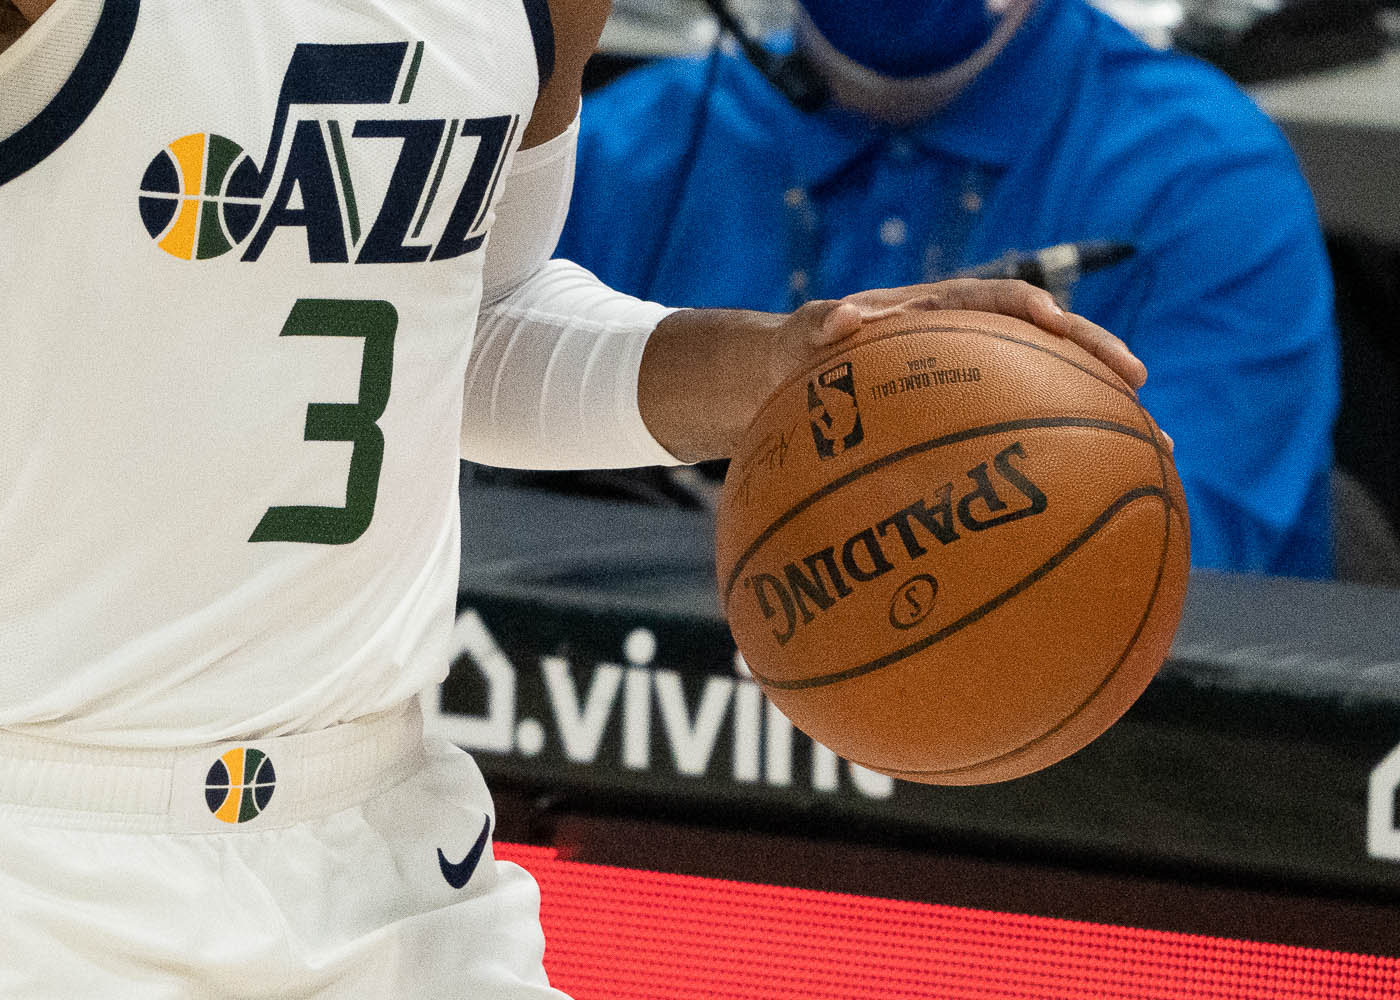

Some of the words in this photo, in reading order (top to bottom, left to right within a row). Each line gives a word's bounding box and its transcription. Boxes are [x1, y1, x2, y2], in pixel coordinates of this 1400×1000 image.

[138, 41, 519, 264] JAZZ
[248, 298, 399, 545] 3
[931, 367, 981, 386] OFFICIAL
[750, 441, 1047, 646] SPALDING
